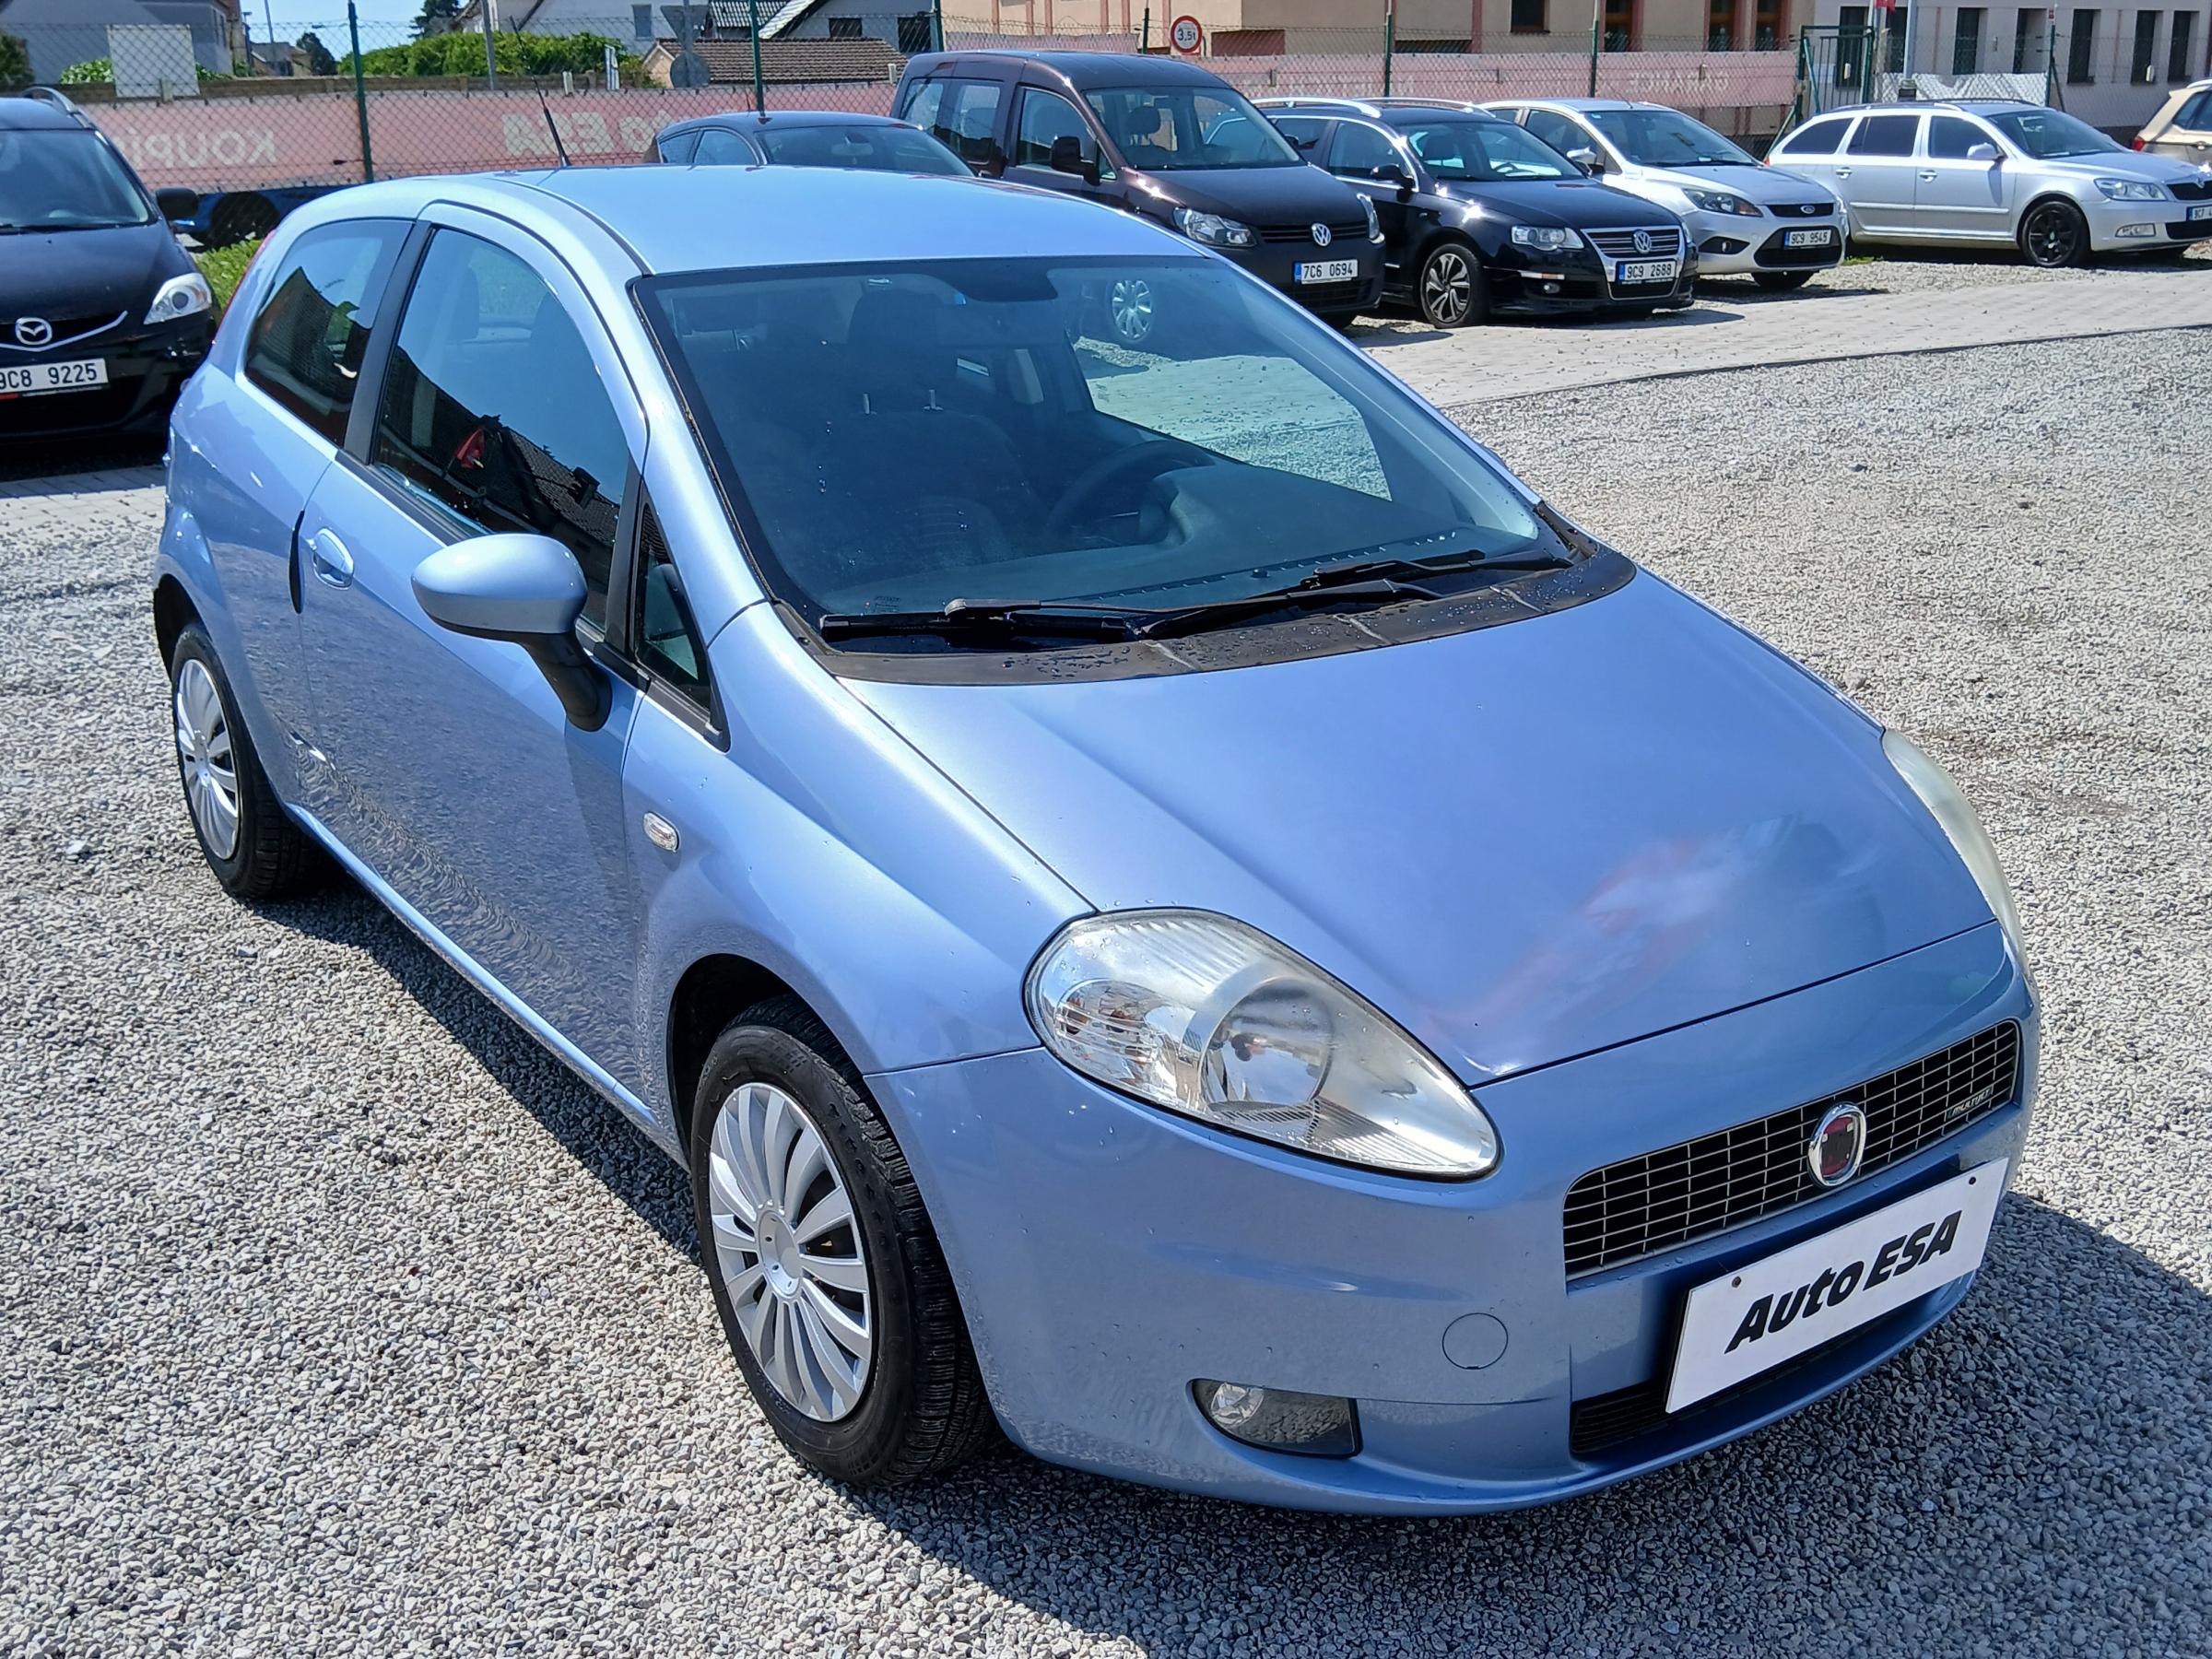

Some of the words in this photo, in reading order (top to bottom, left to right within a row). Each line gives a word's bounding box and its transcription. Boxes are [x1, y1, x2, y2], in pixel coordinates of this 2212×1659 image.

[1810, 231, 1828, 243] 9545
[1303, 265, 1323, 279] 7C6
[1329, 263, 1353, 276] 0694
[1627, 265, 1644, 278] 9C9
[1651, 264, 1672, 276] 2688
[48, 362, 97, 385] 9225
[1724, 1260, 1865, 1355] Auto
[1863, 1209, 1963, 1291] ESA
